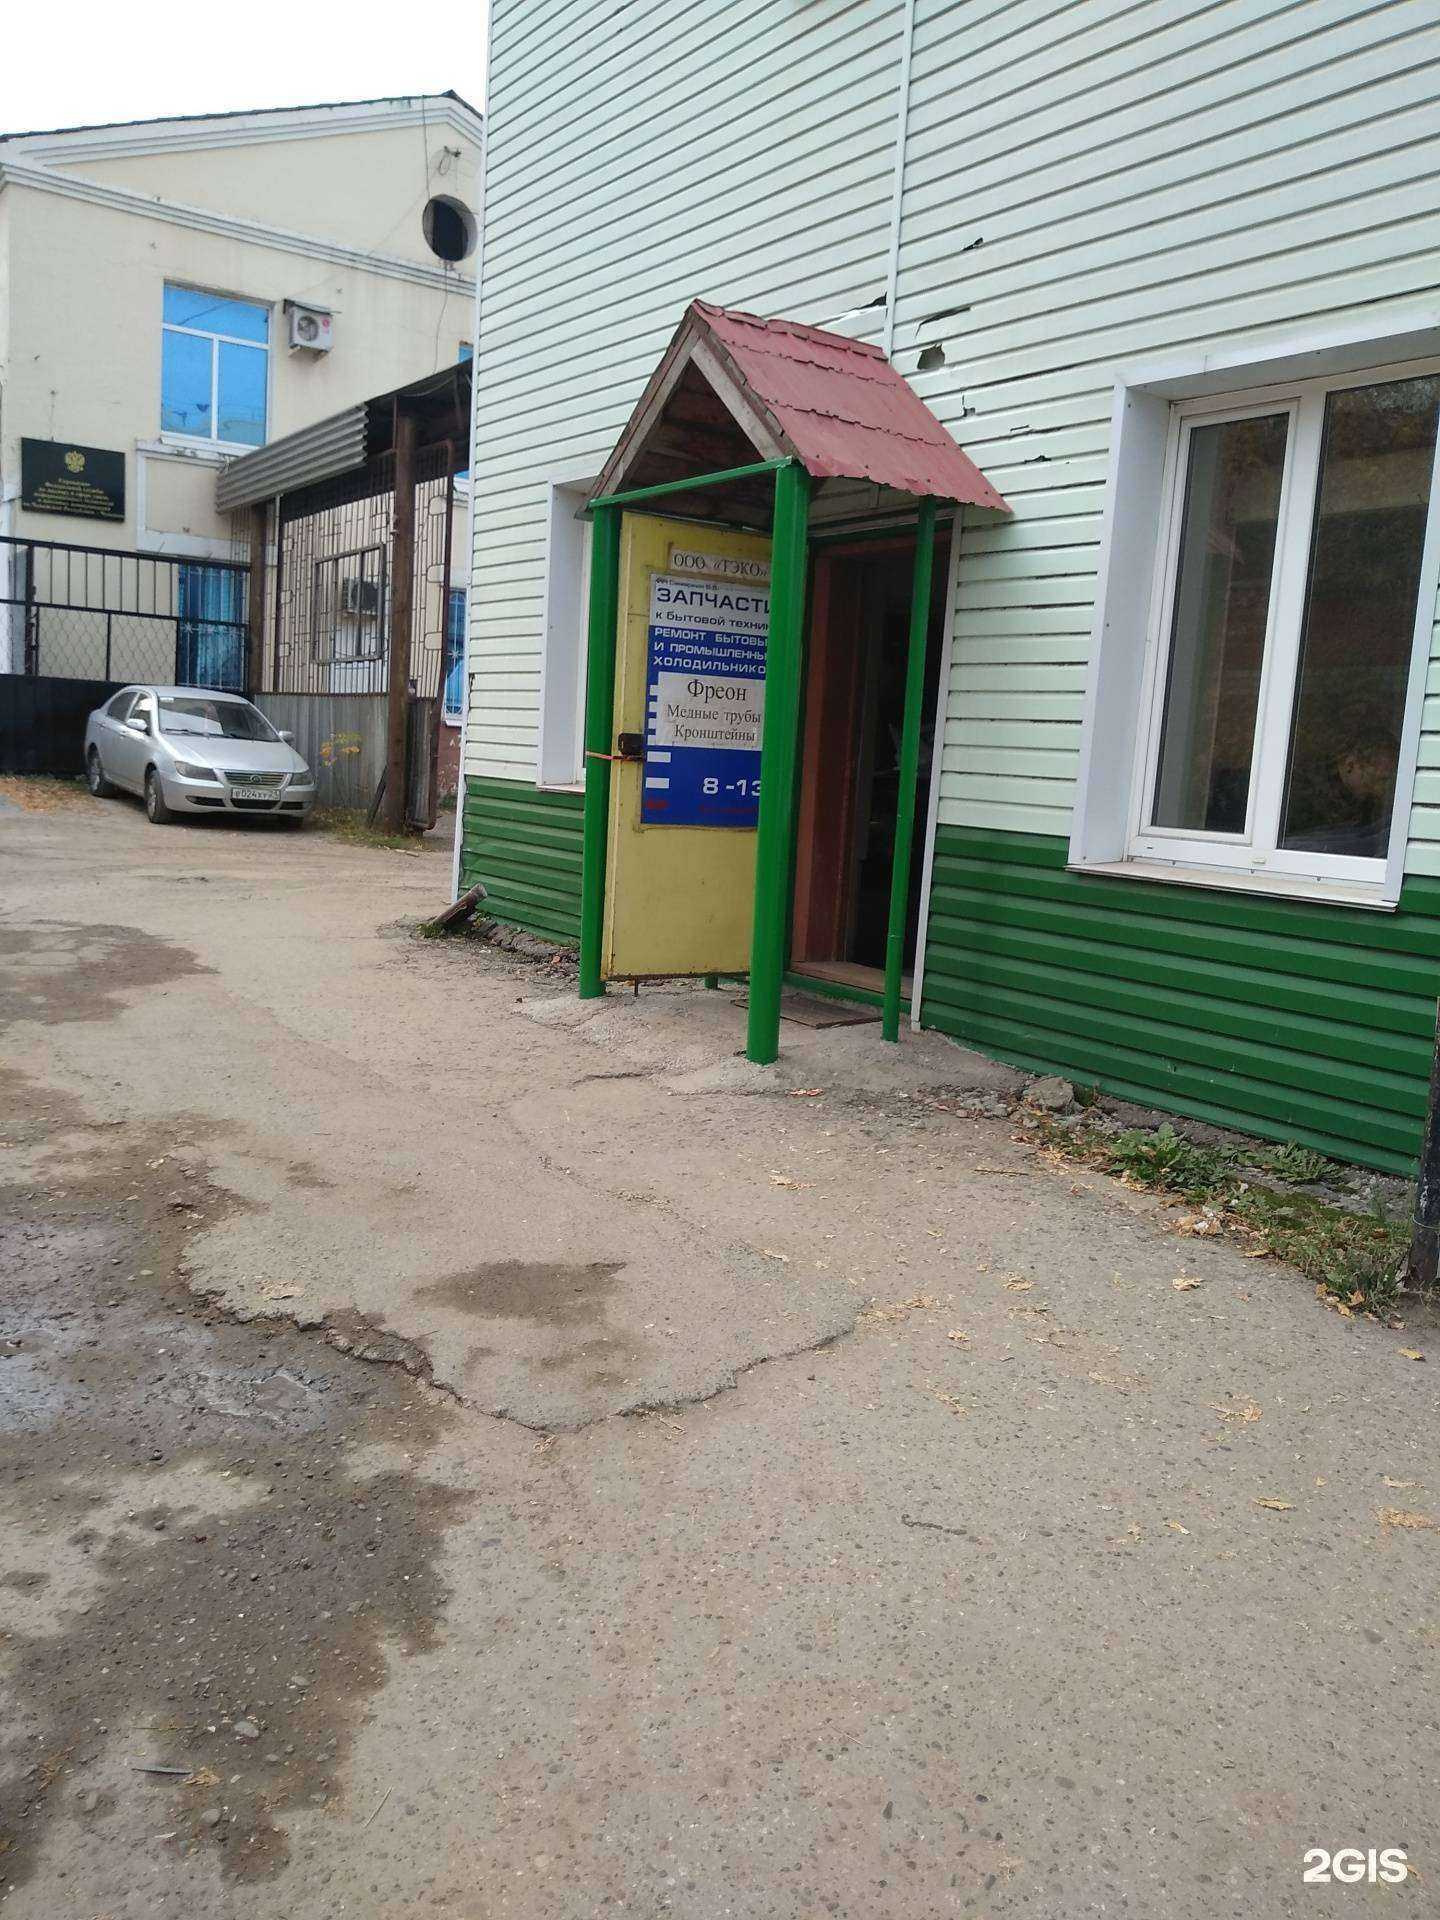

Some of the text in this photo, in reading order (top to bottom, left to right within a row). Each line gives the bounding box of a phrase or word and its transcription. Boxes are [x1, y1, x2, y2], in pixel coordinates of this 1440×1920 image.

[674, 553, 706, 570] ООО
[667, 611, 725, 626] бытовой
[729, 620, 768, 631] техни
[654, 628, 706, 641] РЕМОНТ
[654, 642, 664, 651] И
[687, 679, 747, 703] Фреон
[667, 704, 761, 725] Медные трубы
[674, 724, 756, 742] Кронштейны
